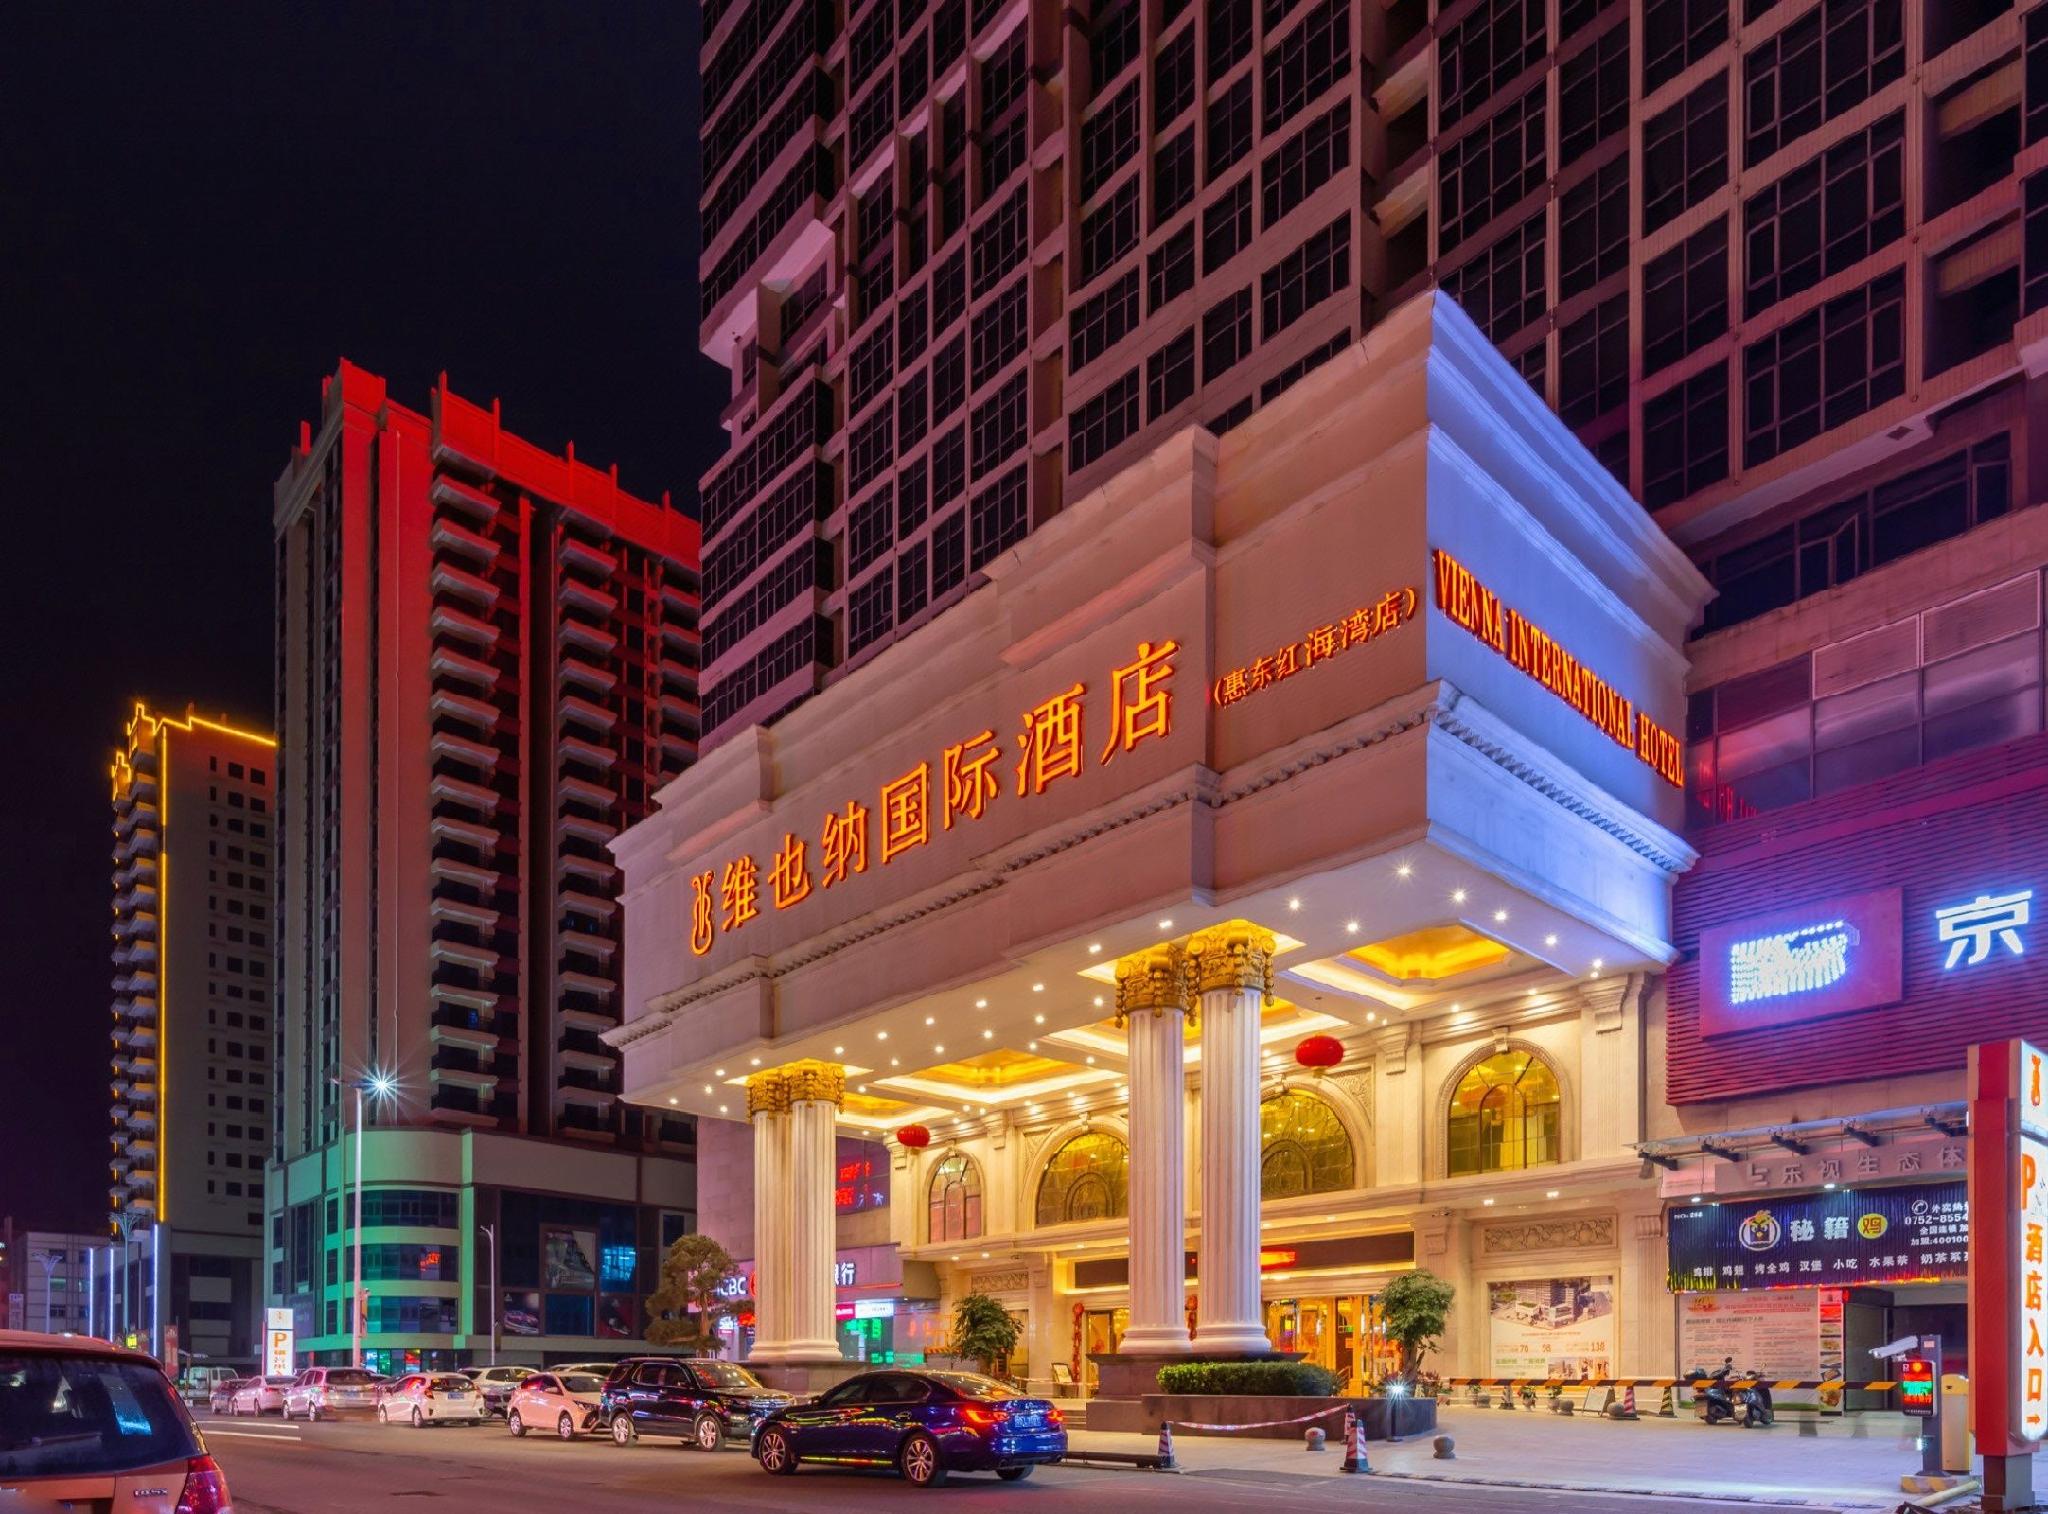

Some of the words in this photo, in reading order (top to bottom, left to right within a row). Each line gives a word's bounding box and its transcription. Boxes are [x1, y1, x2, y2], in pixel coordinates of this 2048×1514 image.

[1214, 587, 1418, 705] (惠东红海湾店)
[1434, 549, 1505, 655] VIENNA
[1506, 608, 1634, 750] INTERNATIONAL
[1635, 712, 1684, 788] HOTEL
[721, 640, 1181, 931] 维也纳国际酒店
[1935, 890, 2032, 969] 京
[2021, 1153, 2036, 1211] P
[1800, 1260, 1822, 1272] 汉堡
[1833, 1258, 1858, 1270] 小吃
[2025, 1222, 2045, 1402] 酒店入口
